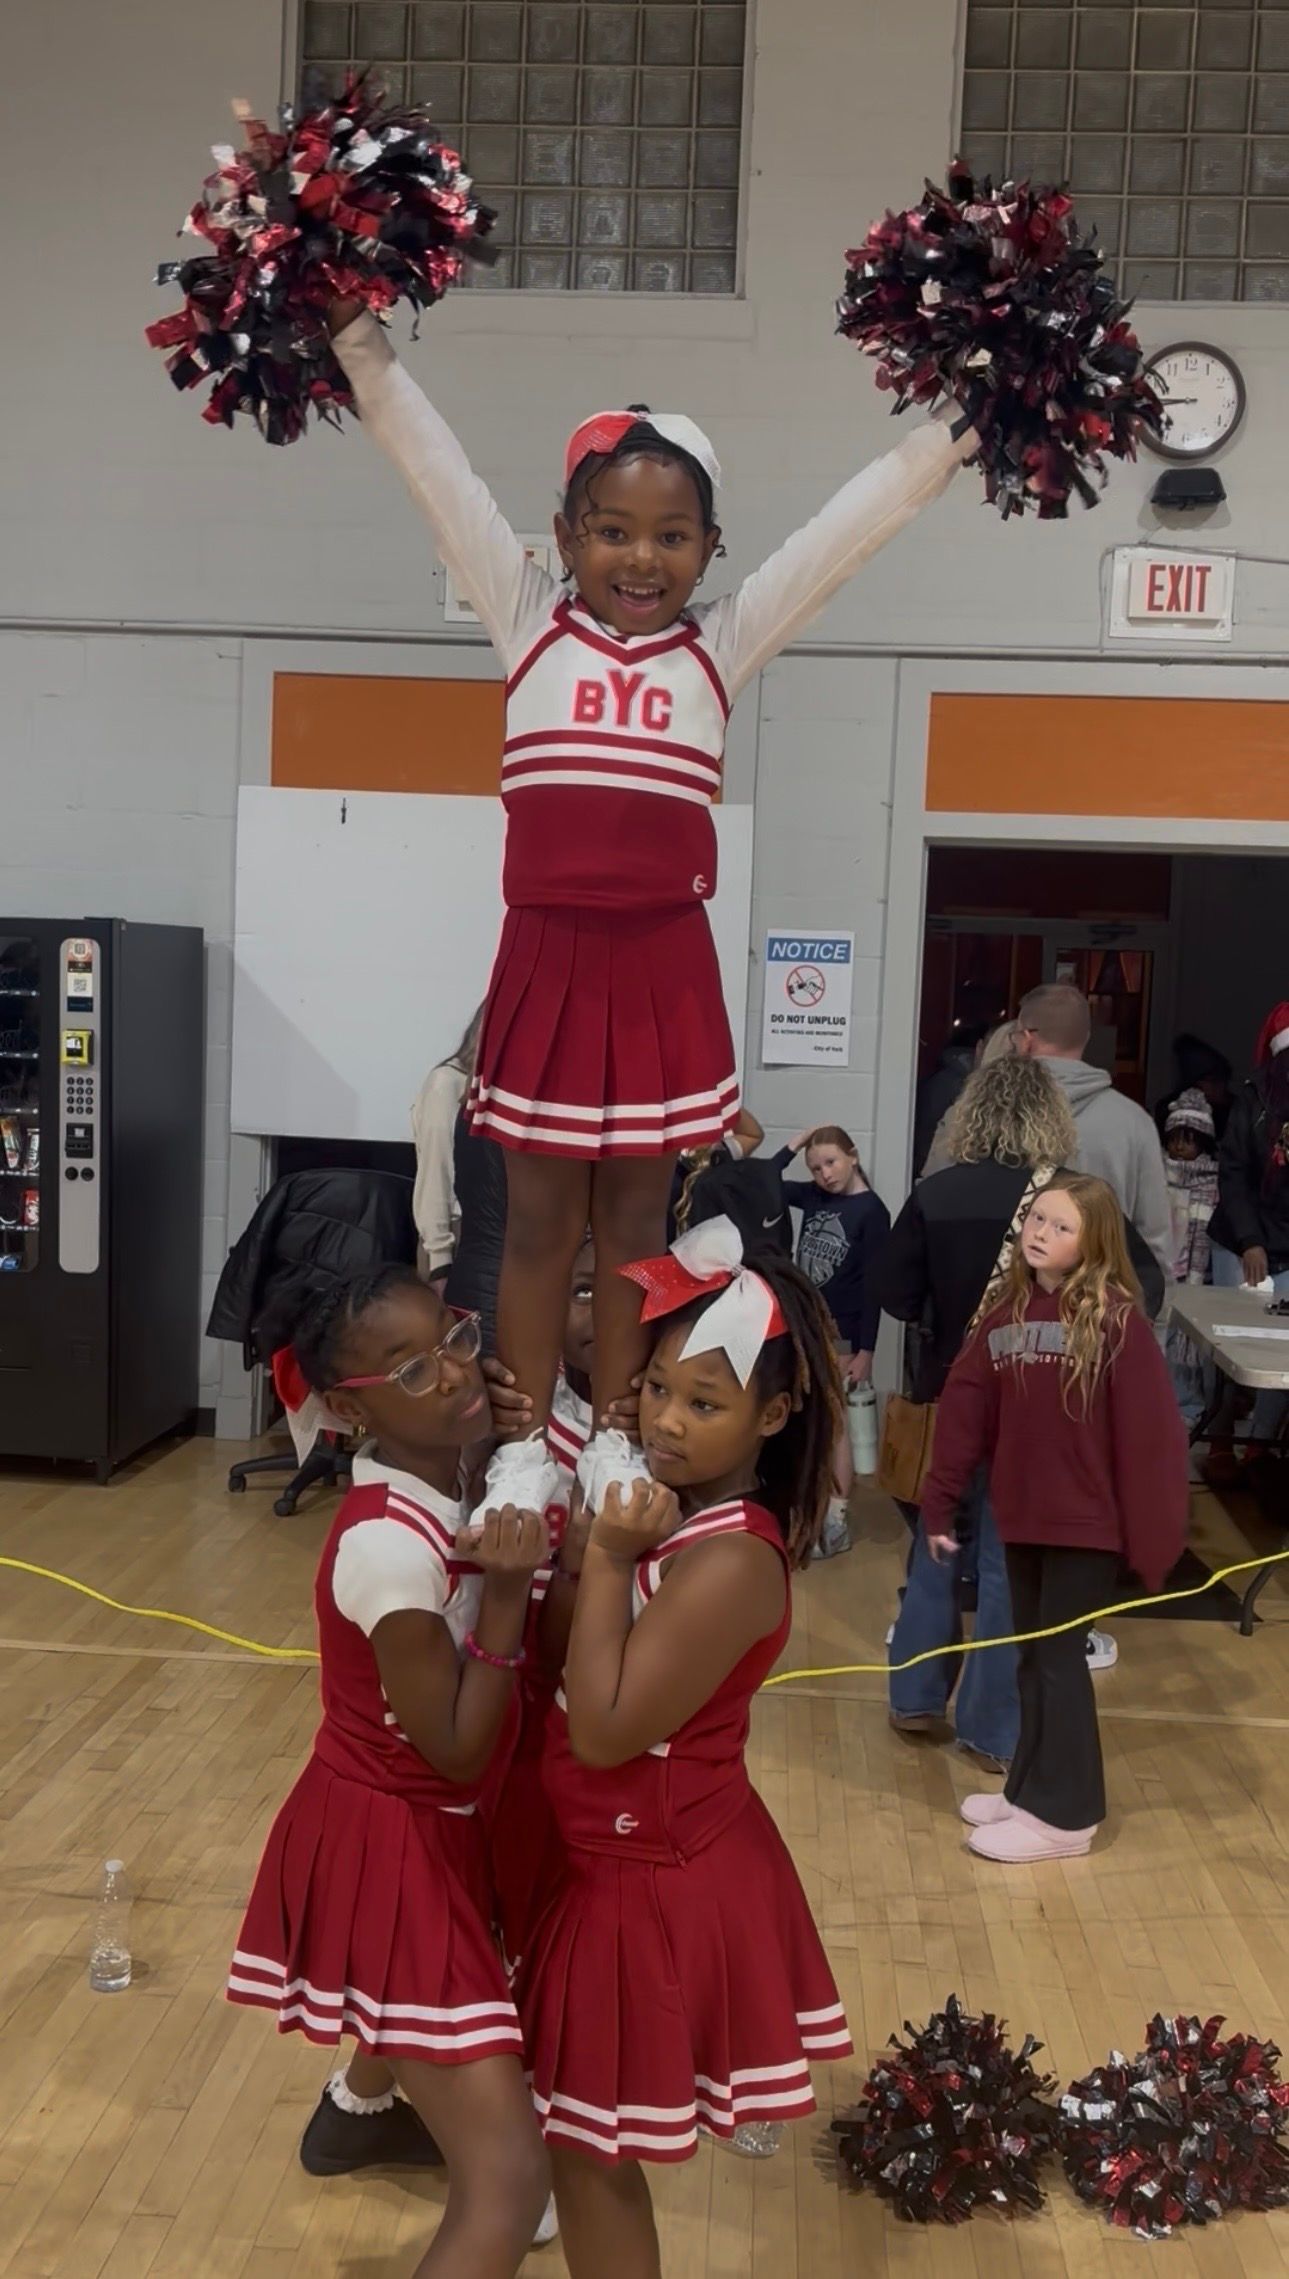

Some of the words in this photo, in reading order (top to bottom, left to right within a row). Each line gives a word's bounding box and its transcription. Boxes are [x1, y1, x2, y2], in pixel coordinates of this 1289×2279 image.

[1184, 357, 1198, 371] 12
[1147, 564, 1213, 613] EXIT
[573, 669, 673, 732] BYC
[771, 942, 848, 960] NOTICE
[771, 1014, 785, 1023] DO
[786, 1015, 805, 1024] NOT
[807, 1016, 847, 1025] UNPLUG
